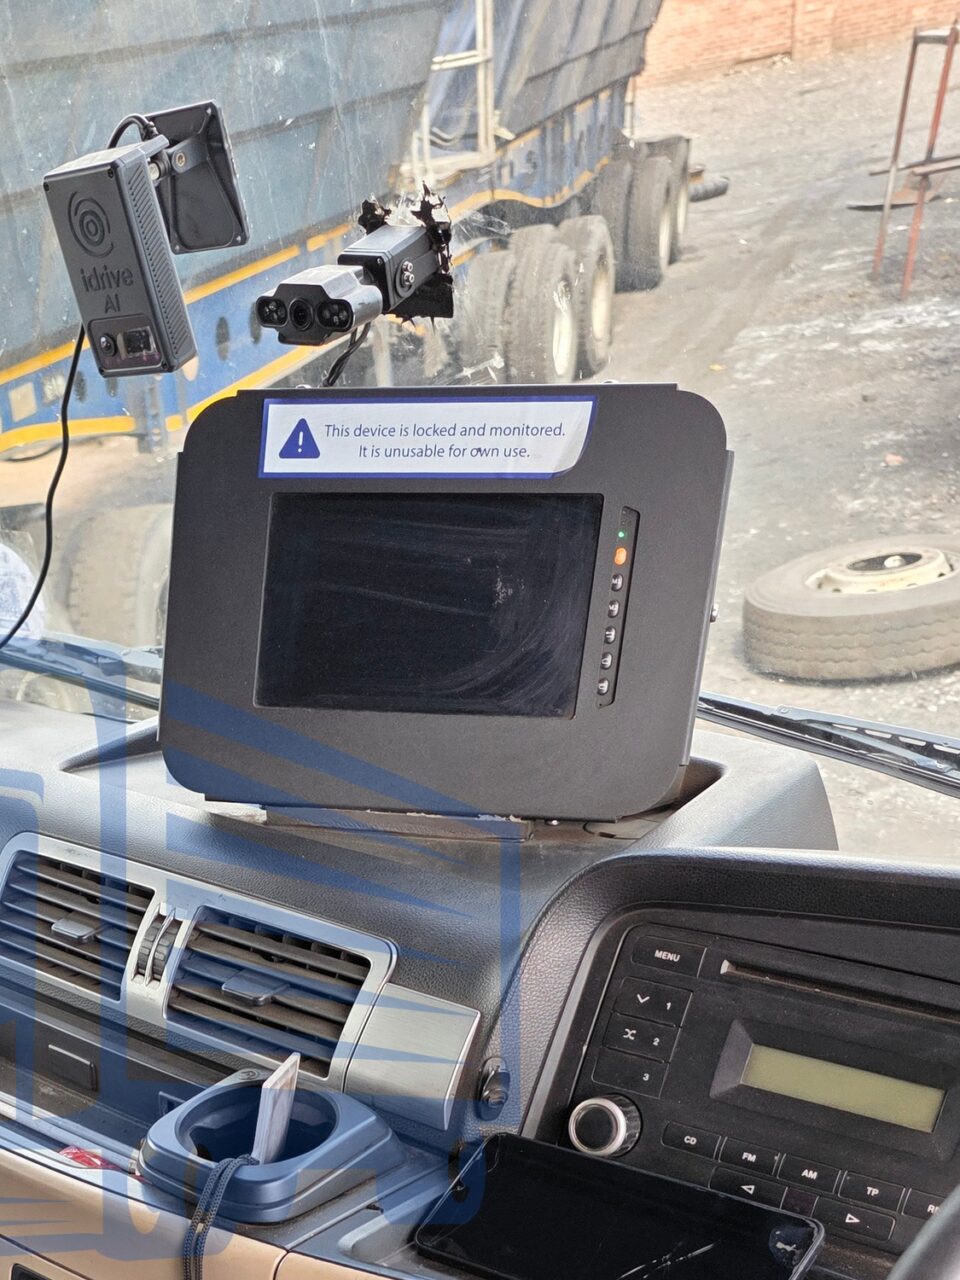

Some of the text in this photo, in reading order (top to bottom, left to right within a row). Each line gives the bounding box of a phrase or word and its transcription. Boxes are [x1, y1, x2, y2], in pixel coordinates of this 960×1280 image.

[81, 265, 134, 292] idrive
[105, 293, 121, 313] AI
[325, 422, 566, 437] This device is locked and monitored.
[359, 444, 531, 458] It is unusable for own use.
[654, 949, 681, 962] MENU
[665, 1002, 672, 1010] 1
[652, 1037, 660, 1046] 2
[642, 1073, 650, 1081] 3
[683, 1135, 697, 1145] CD
[742, 1152, 756, 1163] FM
[801, 1169, 818, 1180] AM
[866, 1186, 879, 1197] TP
